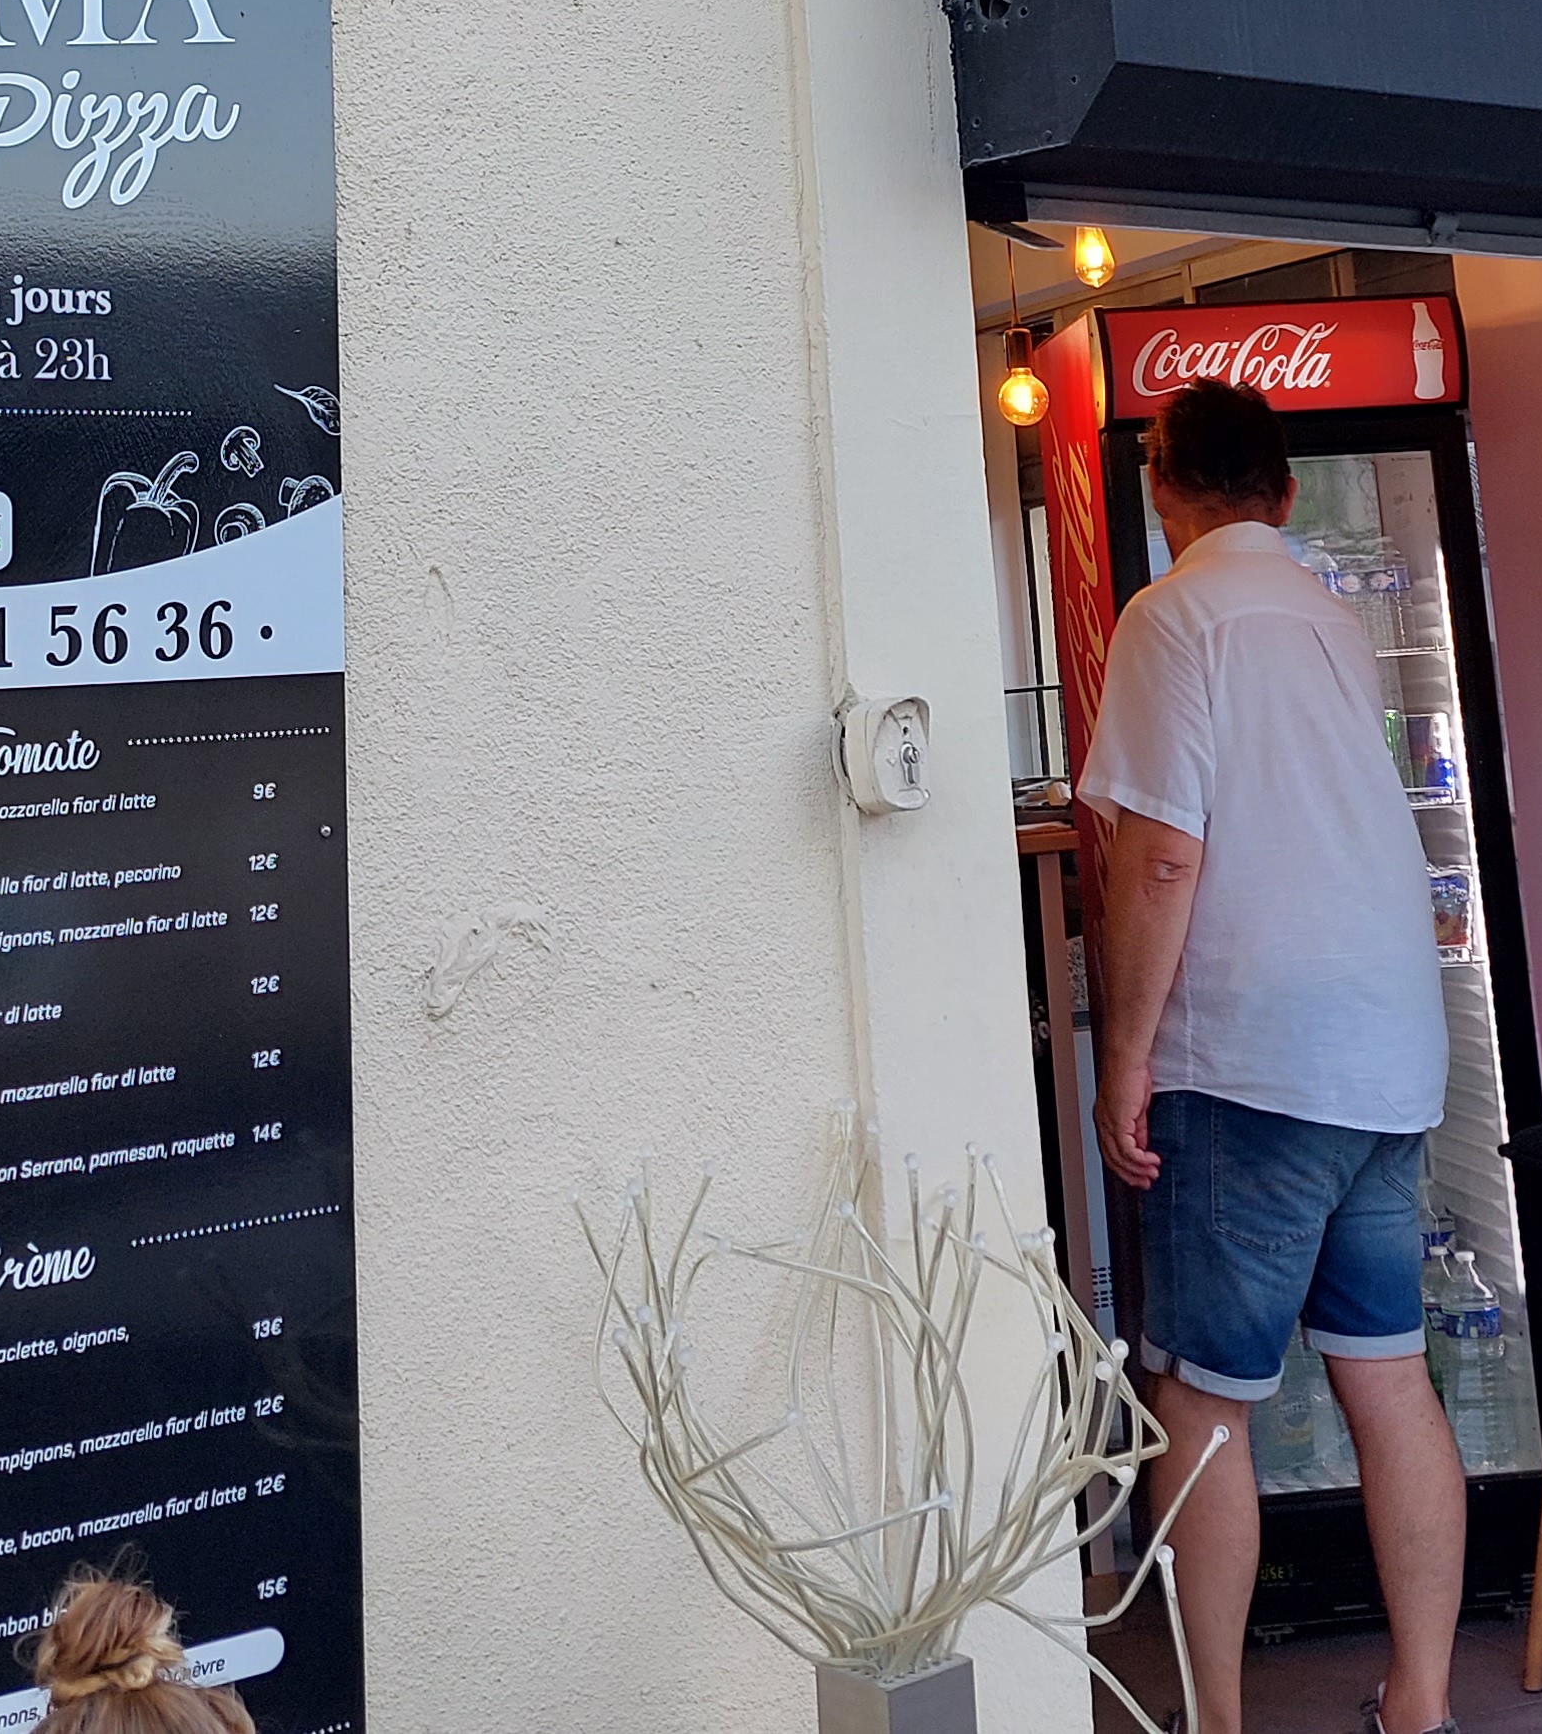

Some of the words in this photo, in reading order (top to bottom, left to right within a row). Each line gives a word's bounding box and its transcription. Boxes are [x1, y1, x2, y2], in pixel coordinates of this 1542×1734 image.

[8, 273, 113, 325] jours
[34, 337, 113, 381] 23h
[1132, 321, 1339, 398] Coca-Cola
[45, 602, 129, 668] 56
[155, 599, 233, 664] 36
[253, 782, 277, 800] 9€
[72, 796, 101, 814] fior
[102, 794, 118, 812] di
[119, 793, 157, 811] latte
[249, 853, 279, 872] 12€
[22, 875, 52, 893] fior
[53, 872, 69, 890] di
[70, 871, 111, 889] latte,
[114, 863, 182, 889] pecorino
[249, 903, 279, 922] 12€
[59, 917, 144, 943] mozzarella
[146, 915, 174, 934] fior
[175, 912, 190, 931] di
[191, 911, 228, 929] latte
[251, 975, 280, 995] 12€
[5, 1006, 21, 1025] di
[23, 1003, 63, 1023] latte
[252, 1049, 282, 1069] 12€
[0, 1075, 89, 1105] mozzarella
[91, 1072, 120, 1092] fior
[121, 1068, 137, 1088] di
[138, 1066, 177, 1086] latte
[252, 1122, 283, 1143] 14€
[20, 1156, 86, 1179] Serrano,
[89, 1143, 168, 1174] parmesan,
[171, 1133, 236, 1158] roquette
[63, 1326, 130, 1354] oignons,
[253, 1317, 283, 1340] 13€
[254, 1395, 285, 1417] 12€
[79, 1421, 163, 1455] mozzarella
[165, 1416, 193, 1437] fior
[194, 1410, 209, 1431] di
[210, 1406, 246, 1427] latte
[255, 1474, 286, 1497] 12€
[21, 1526, 75, 1551] bacon,
[78, 1502, 163, 1538] mozzarella
[165, 1497, 193, 1518] fior
[194, 1491, 210, 1511] di
[211, 1486, 248, 1508] latte
[257, 1576, 288, 1600] 15€
[181, 1657, 226, 1680] èvre
